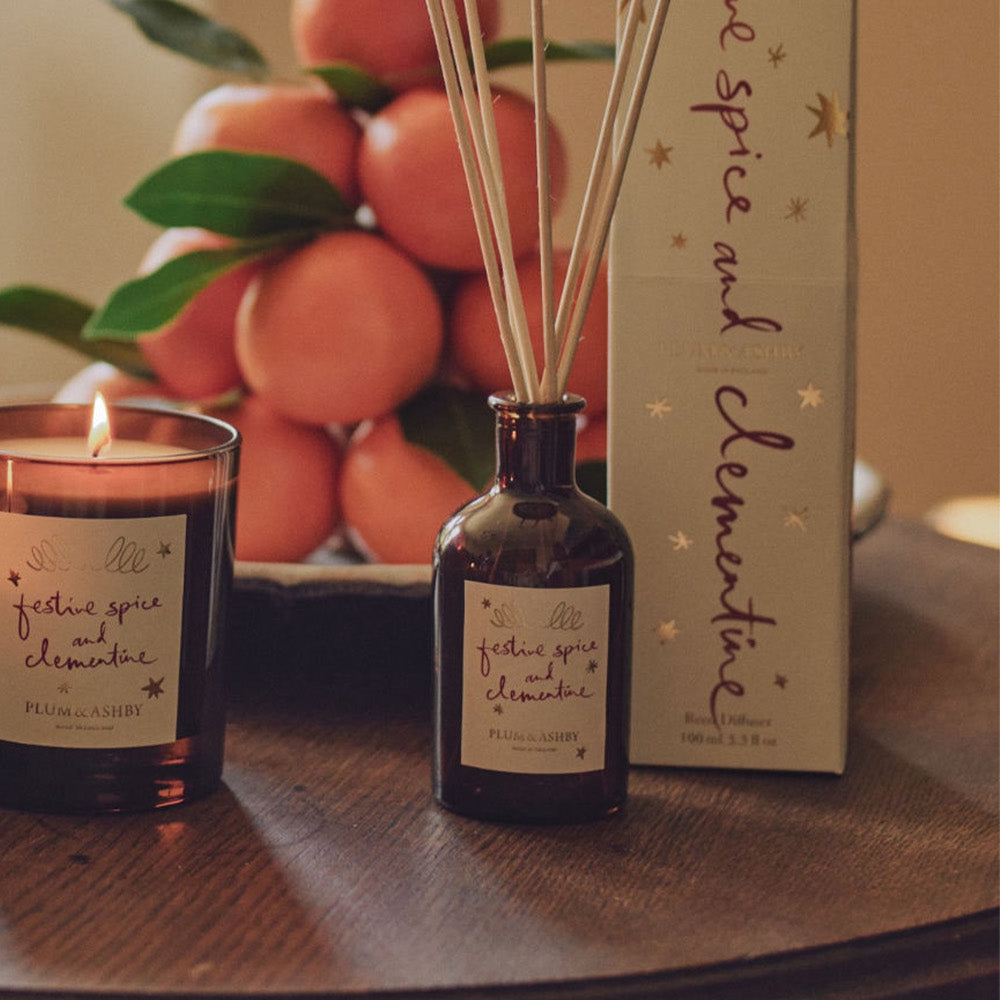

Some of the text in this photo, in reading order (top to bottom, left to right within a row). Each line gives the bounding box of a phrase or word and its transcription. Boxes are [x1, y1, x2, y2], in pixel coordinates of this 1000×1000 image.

[689, 69, 763, 224] spice
[713, 241, 783, 334] and
[710, 384, 796, 730] clementine
[13, 591, 163, 641] festive spice
[72, 621, 107, 647] and
[25, 638, 159, 671] clementine
[477, 635, 598, 677] festive spice
[525, 662, 554, 683] and
[486, 675, 594, 702] clementine
